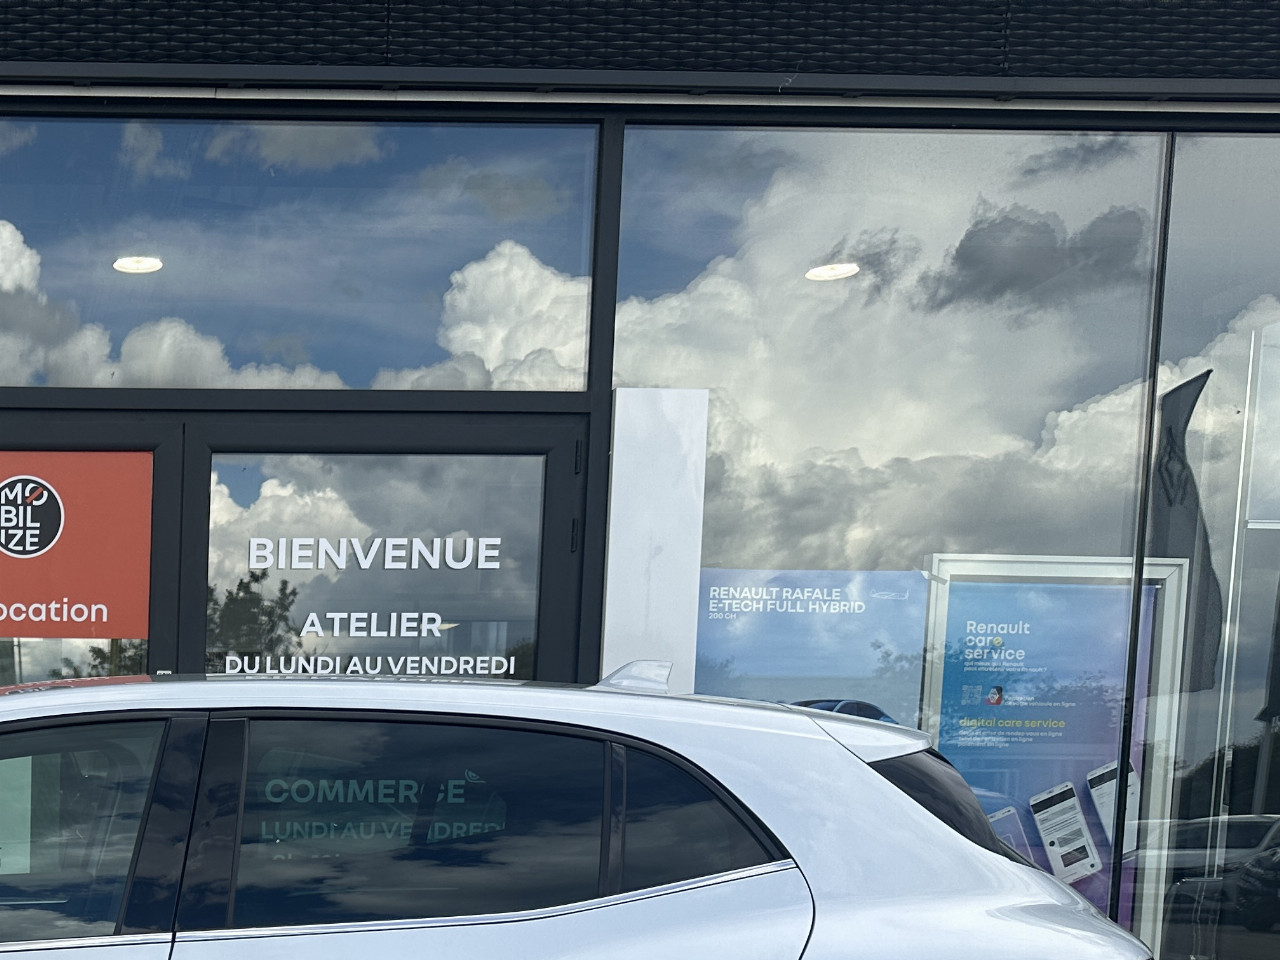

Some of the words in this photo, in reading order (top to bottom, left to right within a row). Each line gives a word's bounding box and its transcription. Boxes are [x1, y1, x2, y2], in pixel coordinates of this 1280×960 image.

[248, 537, 502, 570] BIENVENUE
[709, 587, 779, 599] RENAULT
[782, 588, 841, 600] RAFALE
[709, 600, 763, 612] E-TECH
[767, 601, 805, 613] FULL
[808, 601, 866, 614] HYBRID
[299, 612, 443, 638] ATELIER
[966, 620, 1031, 634] Renault
[965, 635, 1003, 647] care
[964, 647, 1026, 660] service
[225, 656, 260, 675] DU
[265, 656, 341, 675] LUNDI
[346, 656, 382, 675] AU
[387, 656, 516, 675] VENDREDI
[959, 716, 996, 729] digital
[1024, 718, 1066, 728] service
[265, 779, 466, 803] COMMERE
[261, 821, 337, 840] LUNDI
[340, 821, 376, 840] AU
